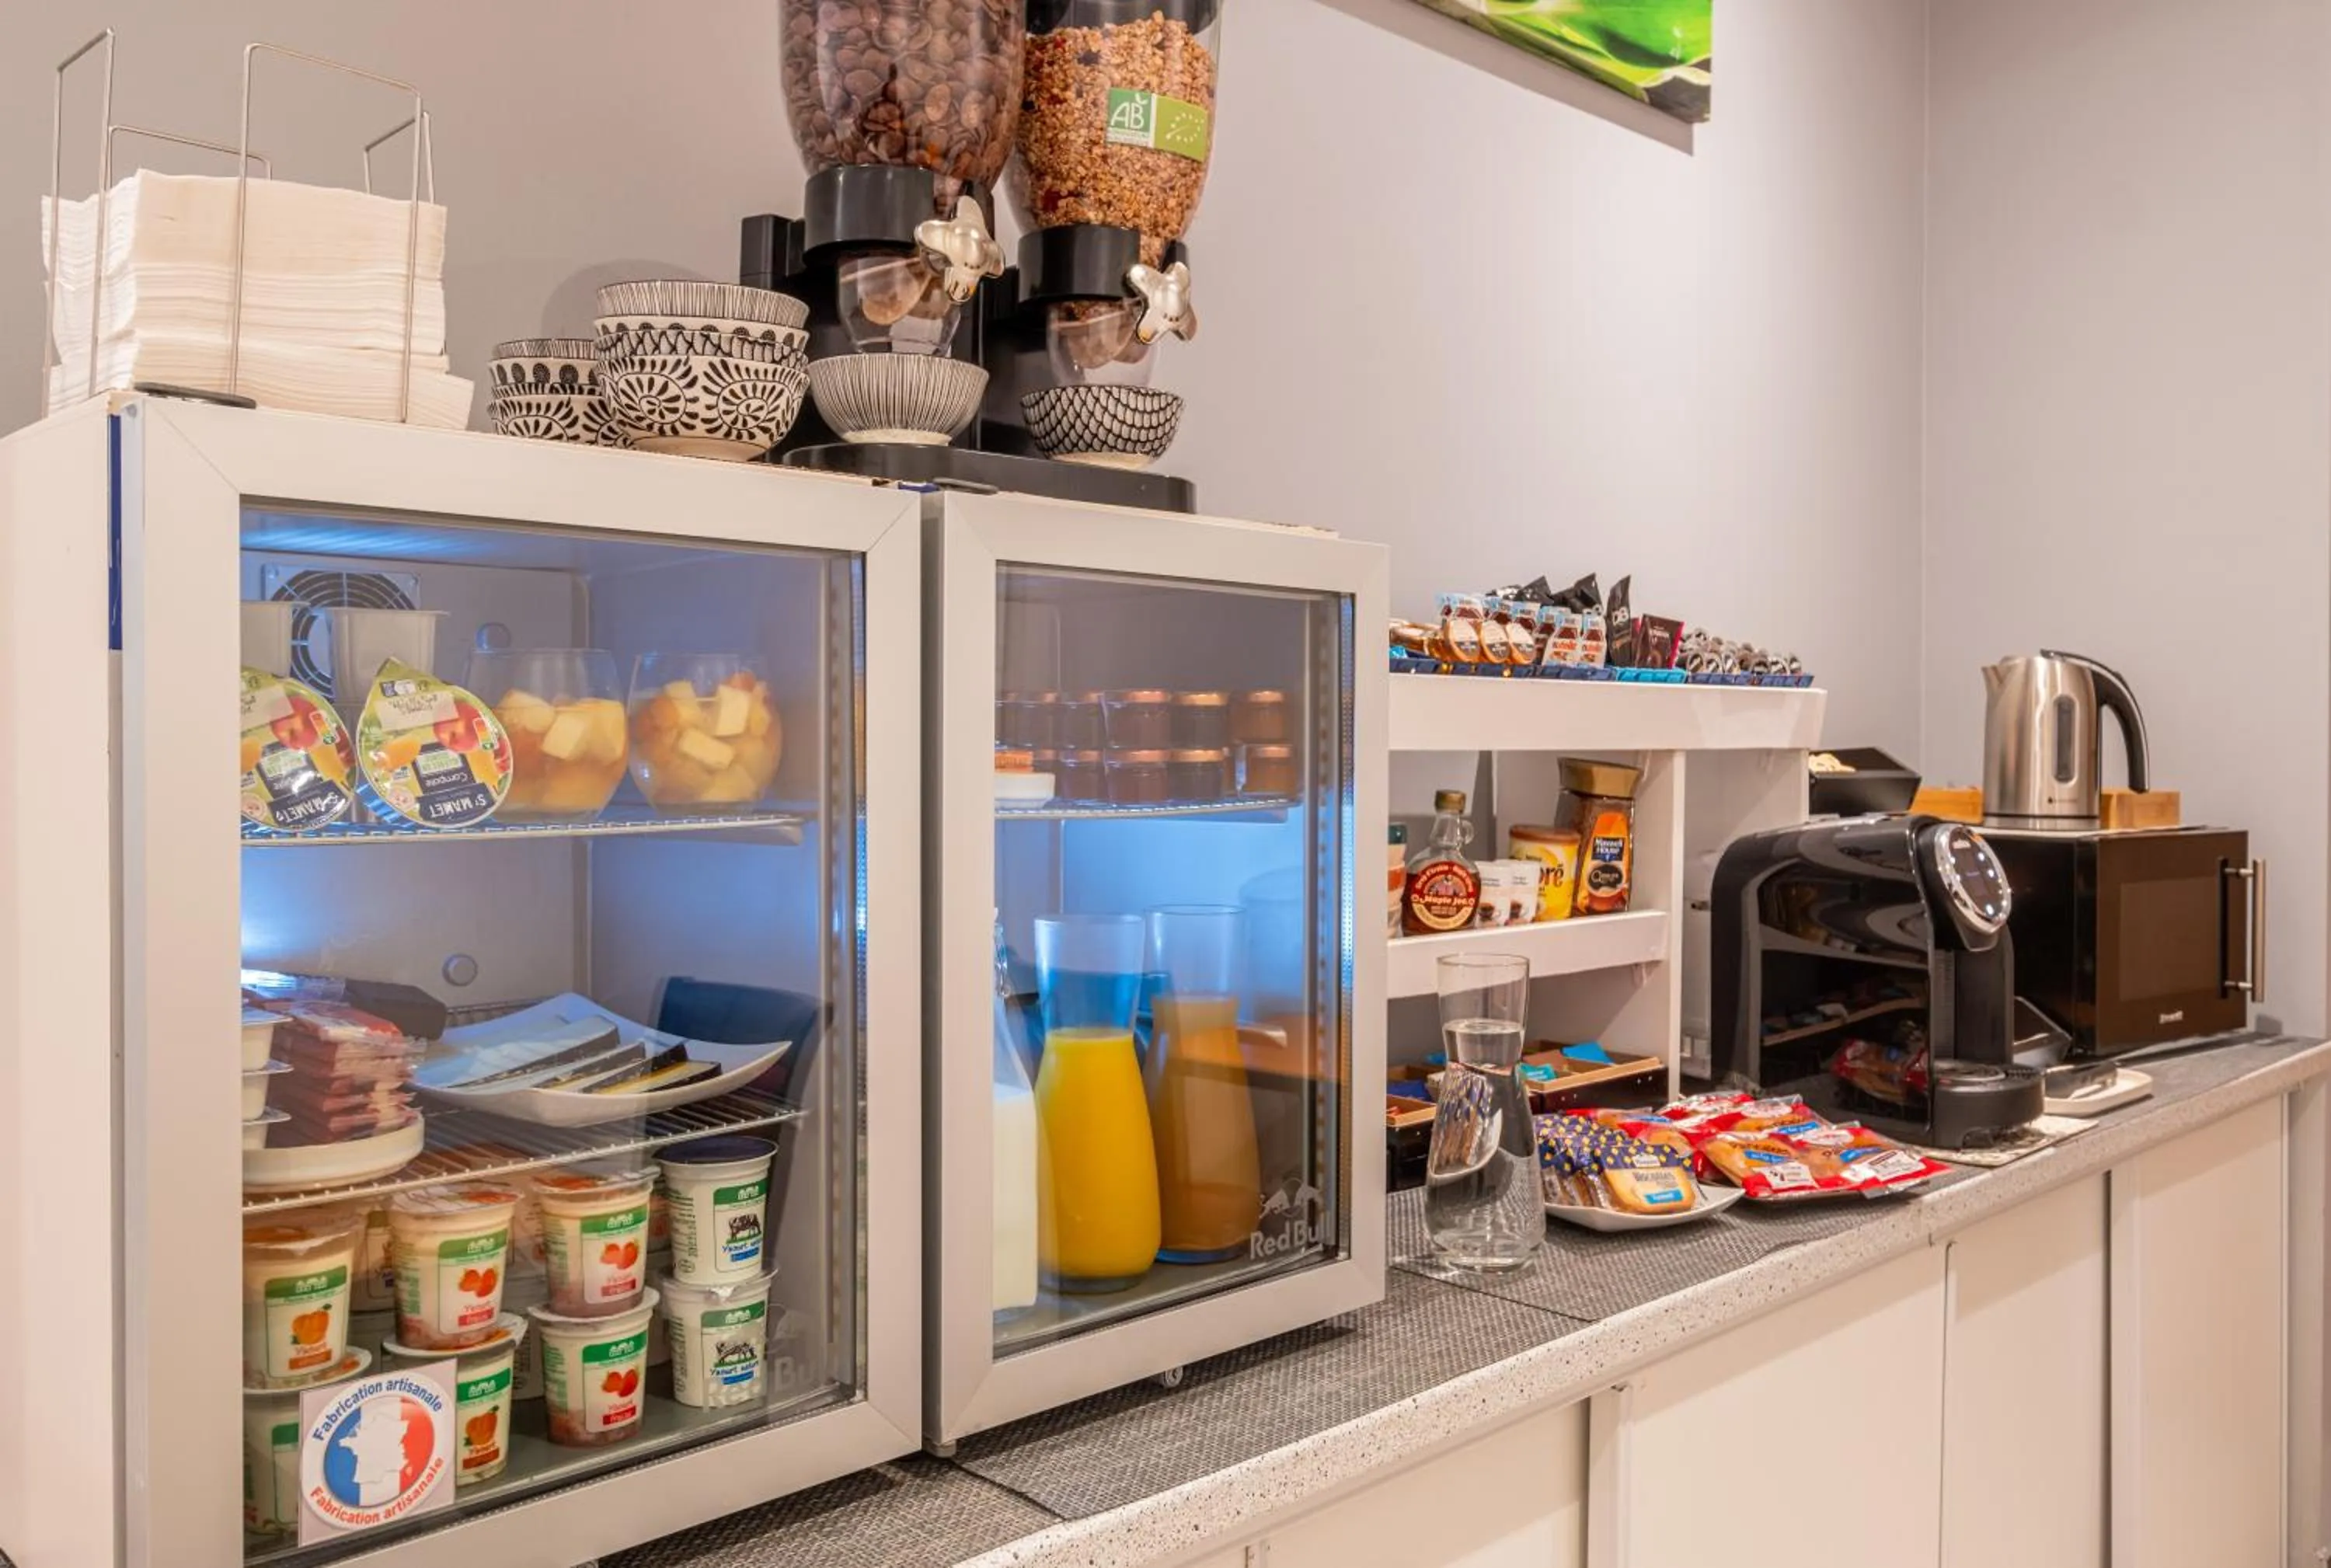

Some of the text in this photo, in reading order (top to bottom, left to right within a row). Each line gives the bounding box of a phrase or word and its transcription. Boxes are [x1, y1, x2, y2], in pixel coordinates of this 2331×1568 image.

[1110, 101, 1145, 130] AB
[427, 796, 473, 818] MAMET
[1249, 1221, 1291, 1260] Red
[312, 1378, 443, 1441] Fabrication artisanale
[311, 1457, 444, 1524] Fabrication artisanale
